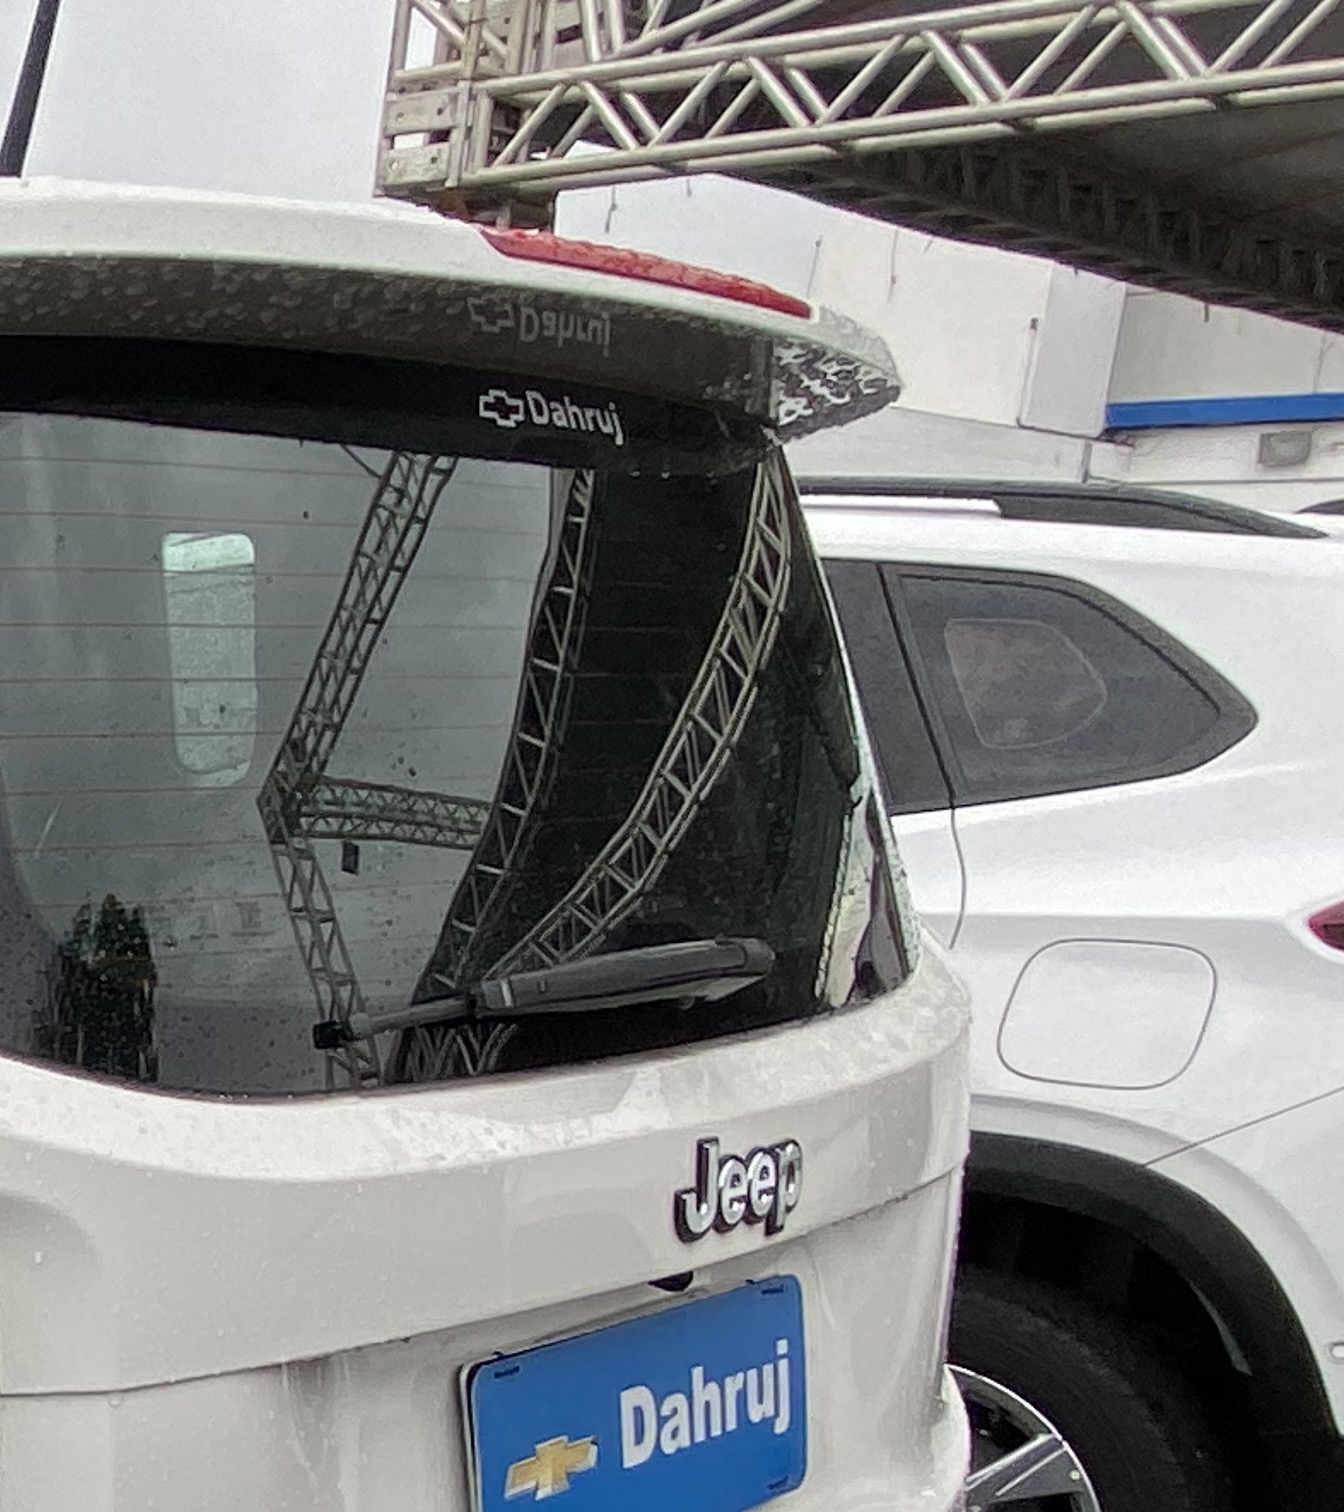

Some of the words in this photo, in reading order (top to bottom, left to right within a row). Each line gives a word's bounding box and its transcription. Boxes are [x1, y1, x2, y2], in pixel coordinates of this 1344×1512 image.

[524, 389, 626, 447] Dahruj
[674, 1137, 804, 1243] Jeep
[617, 1338, 793, 1471] Dahruj
